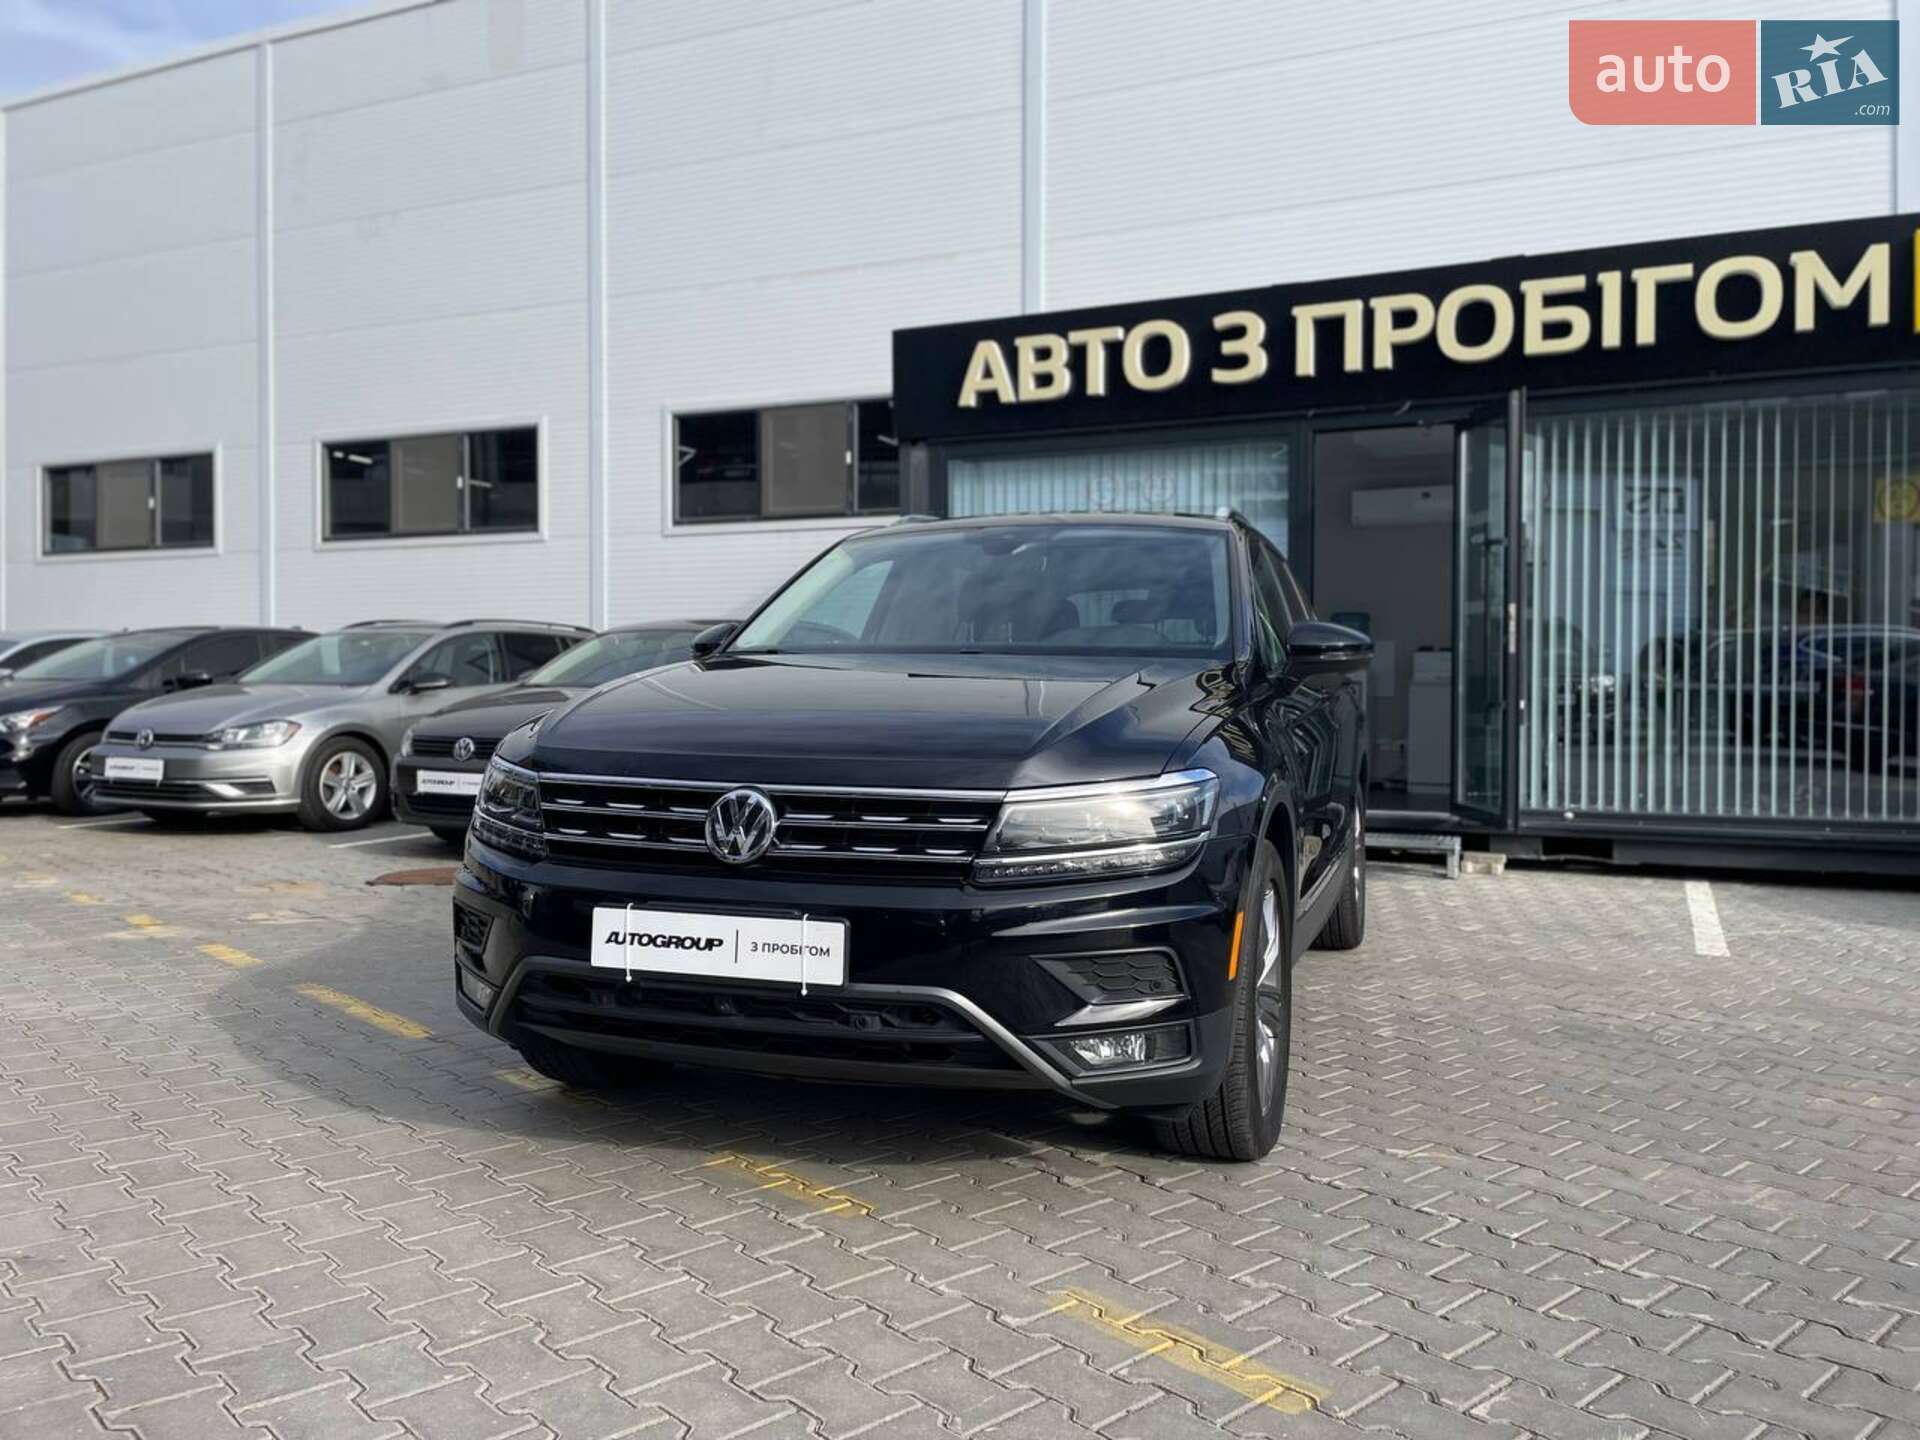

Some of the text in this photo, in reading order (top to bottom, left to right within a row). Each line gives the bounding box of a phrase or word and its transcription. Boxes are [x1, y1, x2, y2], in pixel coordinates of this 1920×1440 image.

[957, 242, 1891, 408] АВТО З ПРОБІГОМ
[605, 931, 724, 952] AUTOGROUP
